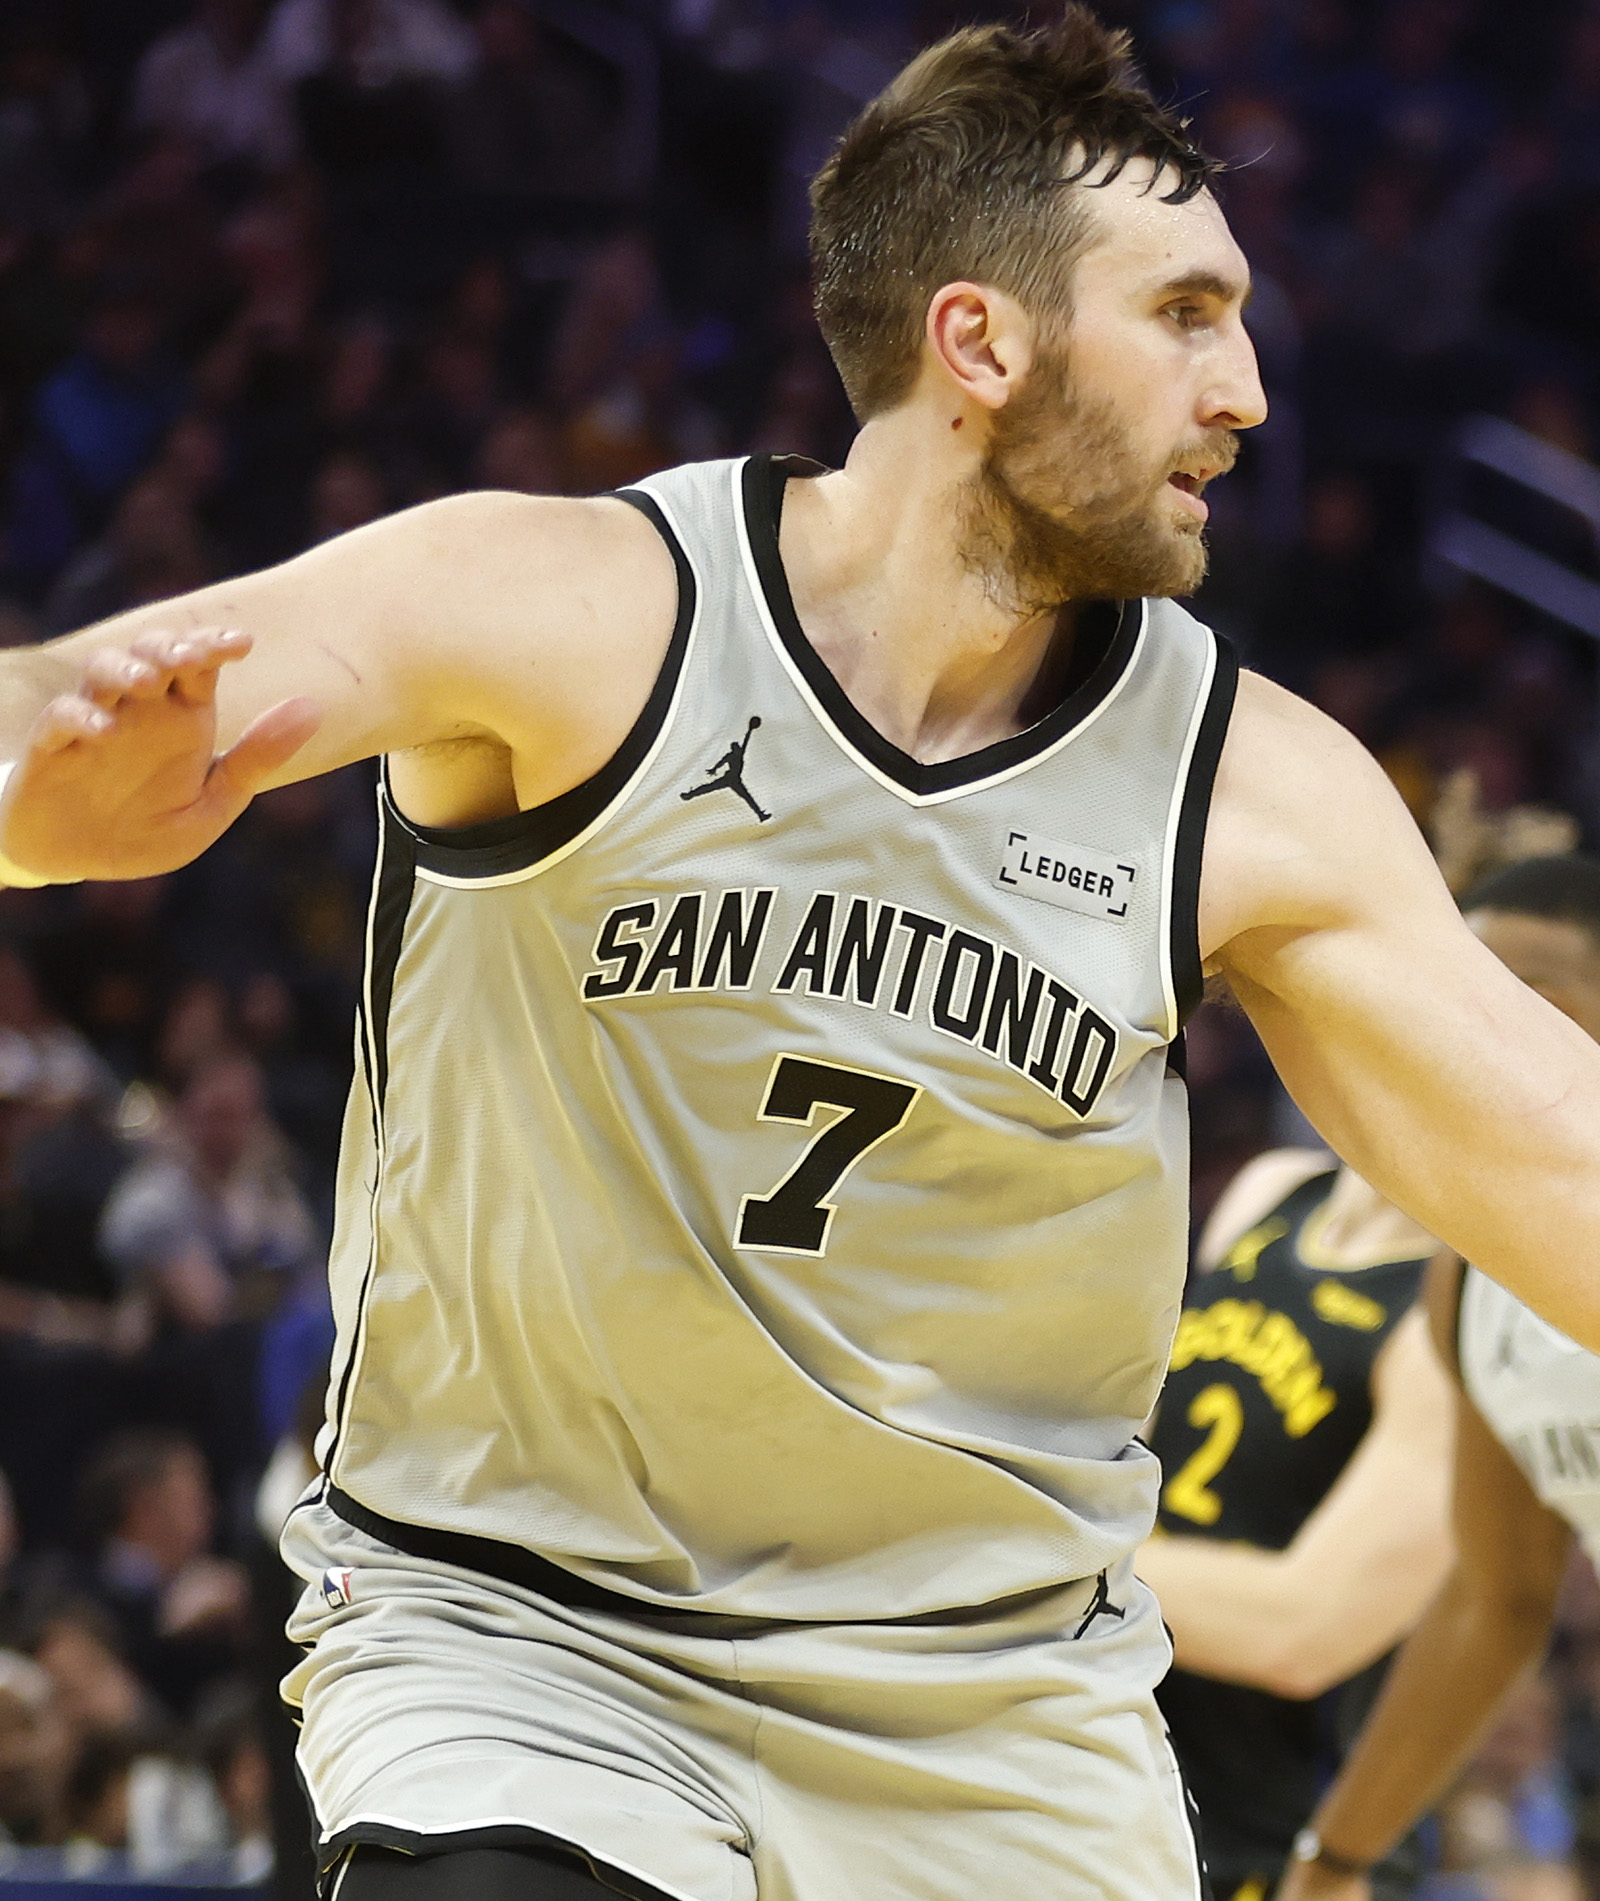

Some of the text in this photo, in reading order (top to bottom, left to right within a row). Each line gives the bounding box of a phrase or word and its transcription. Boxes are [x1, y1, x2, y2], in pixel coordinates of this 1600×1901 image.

[1019, 851, 1115, 900] LEDGER
[583, 886, 1120, 1121] SAN ANTONIO
[732, 1052, 924, 1258] 7
[1163, 1383, 1244, 1526] 2
